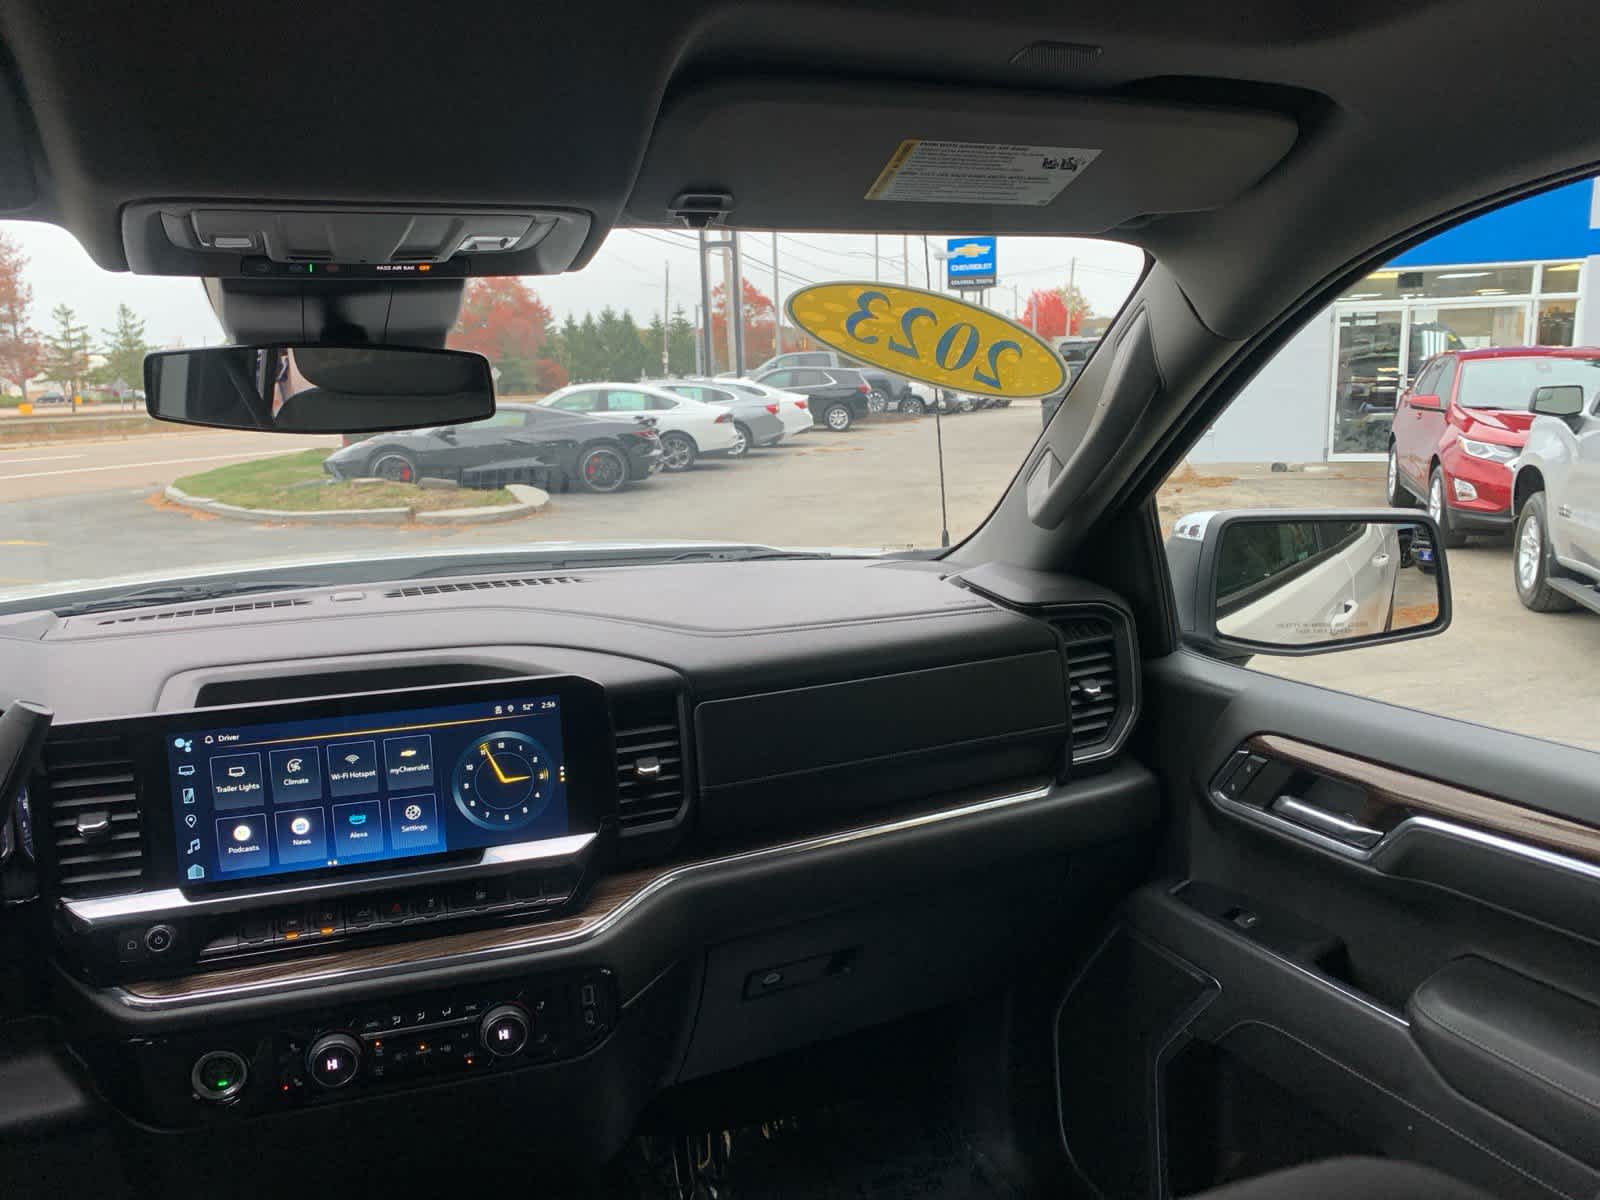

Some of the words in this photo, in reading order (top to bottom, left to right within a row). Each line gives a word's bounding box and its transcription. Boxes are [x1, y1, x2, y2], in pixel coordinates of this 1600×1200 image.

[951, 263, 992, 271] CHEVROLET
[541, 701, 556, 709] 2:56
[218, 734, 240, 743] Driver
[390, 763, 430, 775] myChevrolet
[331, 772, 349, 781] Wi-Fi
[350, 769, 376, 780] Hotspot
[283, 778, 309, 786] Climate
[216, 785, 237, 793] Trailer
[238, 783, 260, 792] Lights
[401, 824, 428, 833] Settings
[228, 845, 260, 854] Podcasts
